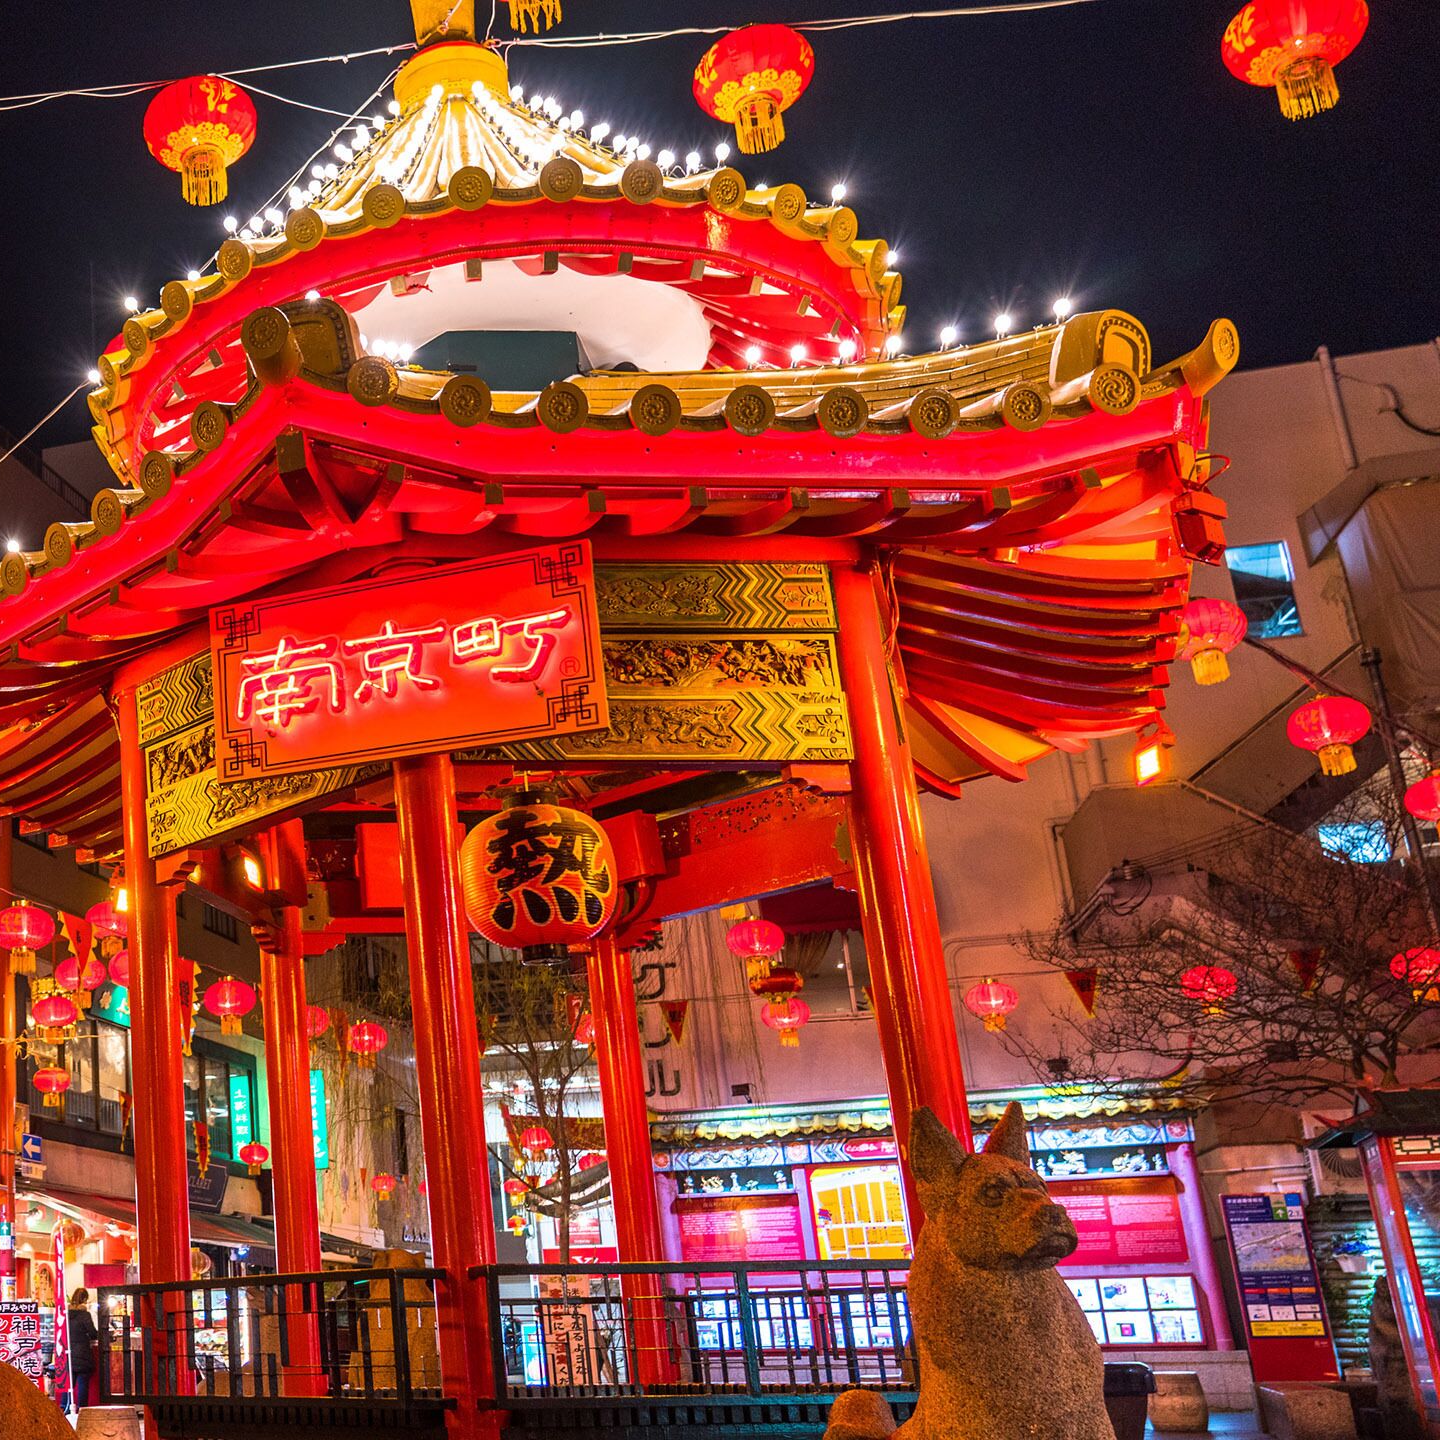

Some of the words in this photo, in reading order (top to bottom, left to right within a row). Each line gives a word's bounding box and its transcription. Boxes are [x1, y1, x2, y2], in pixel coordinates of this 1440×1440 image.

[236, 606, 568, 724] 南京町
[485, 810, 613, 931] 熱
